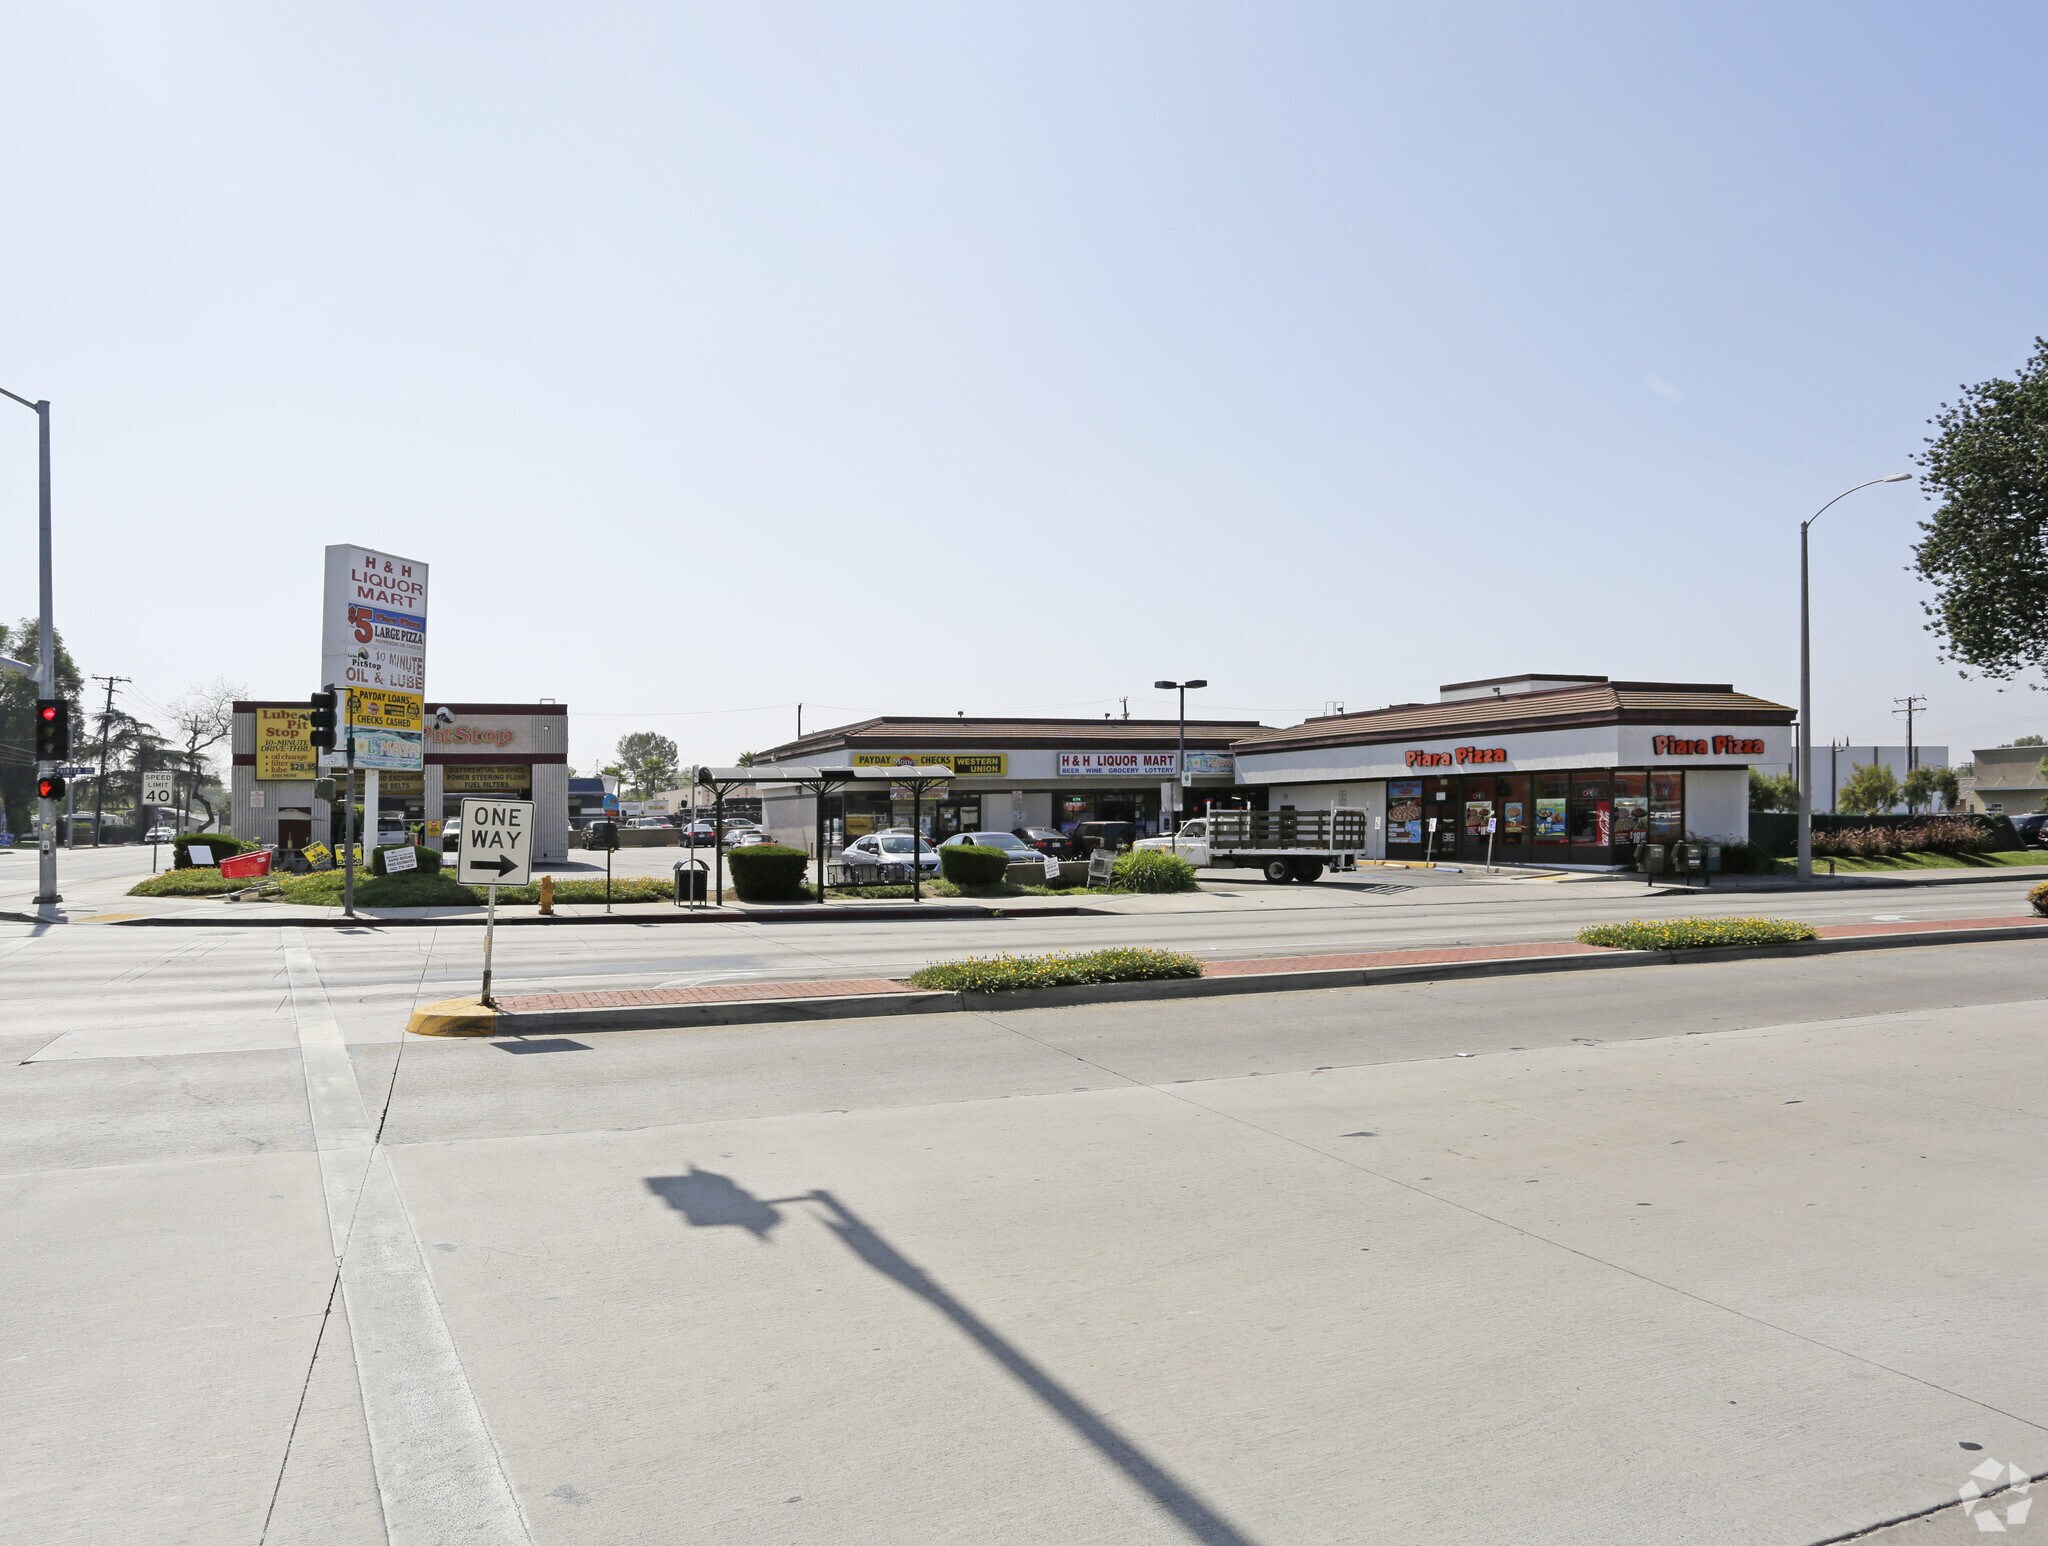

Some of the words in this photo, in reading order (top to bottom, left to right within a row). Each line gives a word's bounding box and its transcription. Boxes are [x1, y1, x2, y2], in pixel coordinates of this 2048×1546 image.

[366, 556, 376, 570] H
[384, 561, 393, 573] &
[402, 565, 411, 578] H
[352, 569, 423, 596] LIQUOR
[357, 586, 417, 608] MART
[348, 606, 373, 644] $5
[375, 626, 400, 641] LARGE
[401, 630, 422, 644] PIZZA
[352, 659, 381, 670] PitStop
[376, 650, 386, 661] 10
[389, 653, 423, 675] MINUTE
[346, 667, 368, 683] OIL
[374, 672, 383, 685] &
[390, 674, 423, 690] LUBE
[360, 691, 386, 701] PAYDAY
[388, 694, 410, 704] LOANS
[262, 710, 298, 720] Lube
[358, 715, 383, 724] CHECKS
[386, 718, 411, 727] CASHED
[266, 727, 299, 738] Stop
[287, 720, 308, 729] Pit
[380, 740, 420, 758] MAYA
[1652, 735, 1708, 755] Piara
[1712, 735, 1764, 755] Pizza
[859, 756, 890, 764] PAYDAY
[1062, 756, 1069, 766] H
[1072, 756, 1080, 766] &
[1083, 756, 1090, 766] H
[1098, 755, 1137, 767] LIQUOR
[1144, 756, 1174, 766] MART
[1405, 750, 1452, 767] Piara
[1455, 746, 1507, 764] Pizza
[146, 790, 170, 802] 40
[474, 807, 522, 827] ONE
[472, 830, 522, 849] WAY
[1405, 820, 1420, 842] $5
